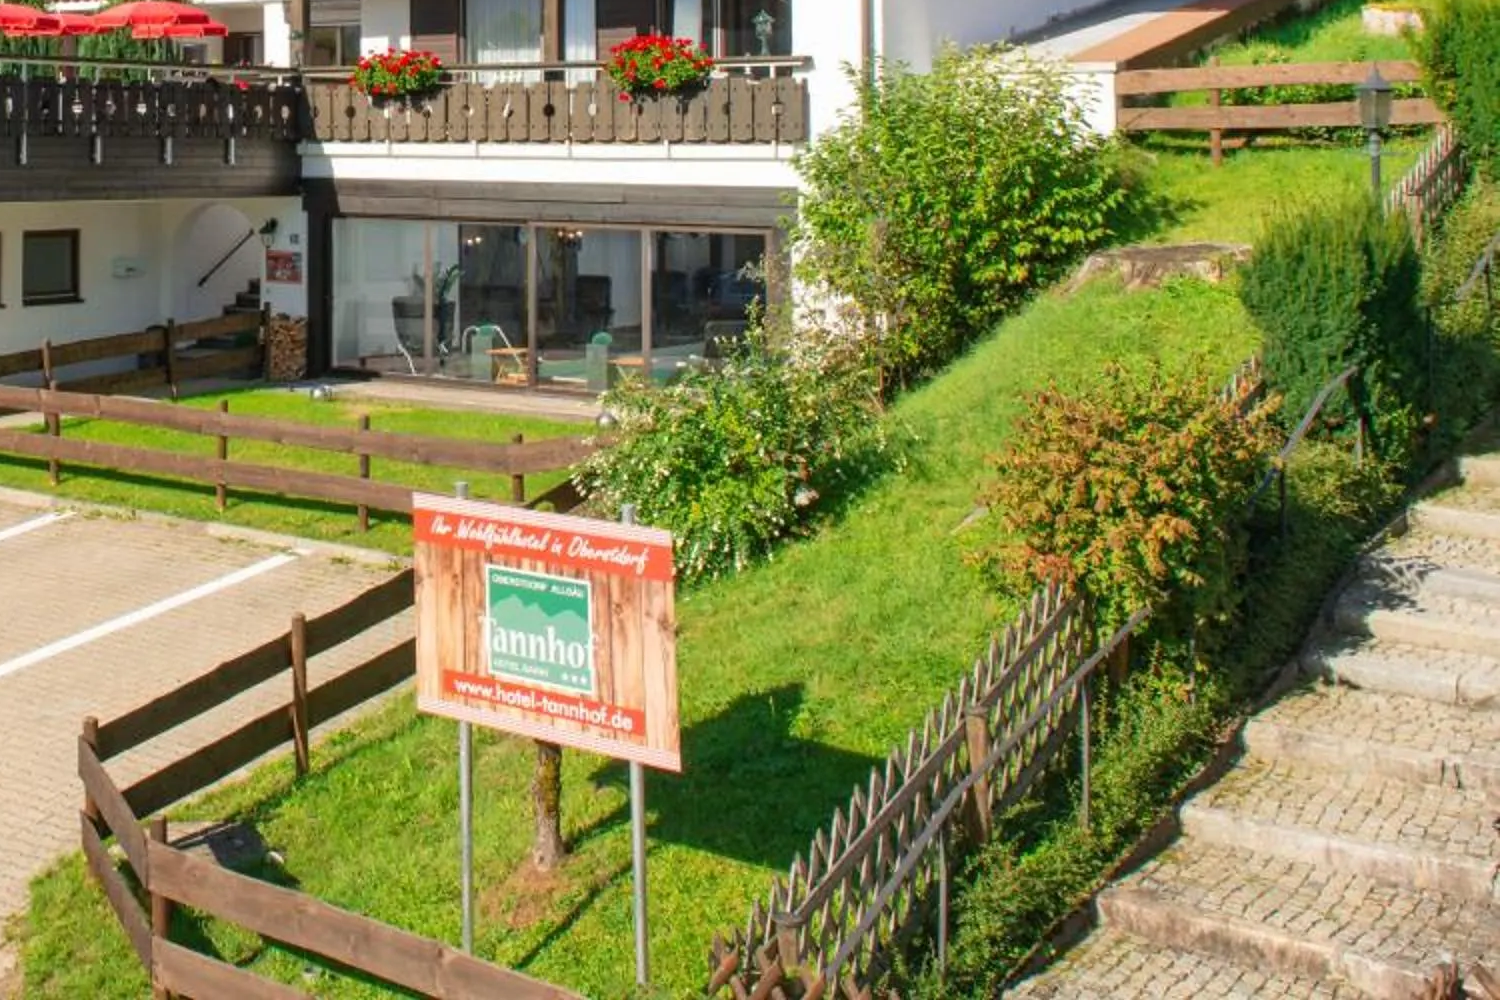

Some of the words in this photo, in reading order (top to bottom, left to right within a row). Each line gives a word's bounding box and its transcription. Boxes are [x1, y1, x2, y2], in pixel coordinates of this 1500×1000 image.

[550, 537, 563, 556] in
[568, 536, 649, 575] Oberstdorf
[478, 613, 600, 669] Tannhof
[454, 678, 633, 731] www.hotel-tannhof.de
